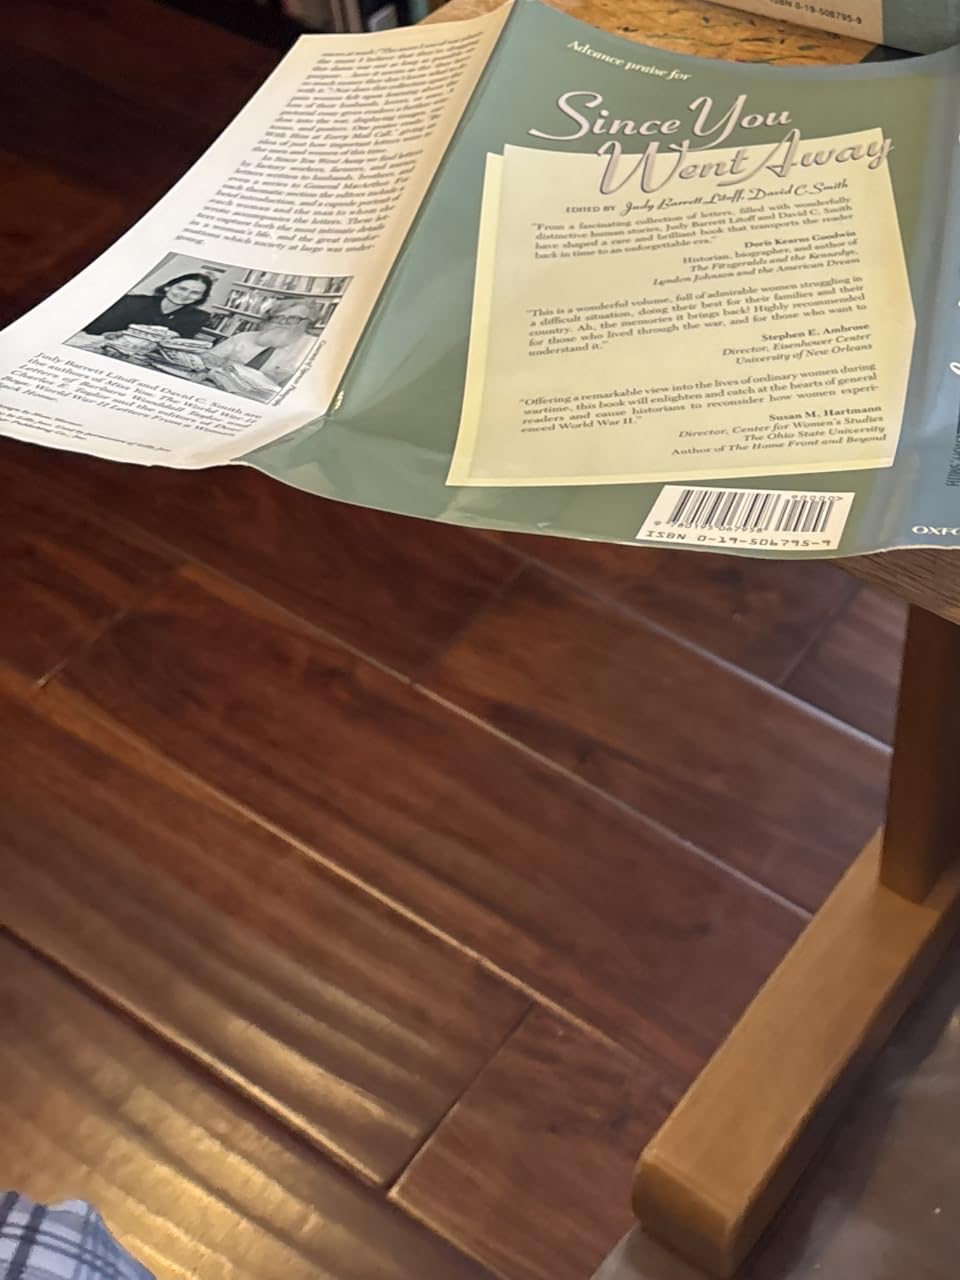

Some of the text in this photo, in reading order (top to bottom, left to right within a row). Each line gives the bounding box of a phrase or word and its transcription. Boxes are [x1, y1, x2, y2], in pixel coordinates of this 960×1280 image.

[567, 40, 692, 81] Advance praise for
[528, 91, 793, 152] Since You
[597, 128, 895, 195] Went Away
[565, 206, 600, 214] EDITED
[603, 205, 616, 213] BY
[620, 199, 655, 217] Judy
[657, 195, 703, 210] Barrett
[747, 184, 794, 201] David
[809, 178, 848, 196] Smith
[744, 230, 856, 248] Doris Kearns Goodwin
[761, 323, 870, 343] Stephen E. Ambrose
[520, 397, 571, 406] “Offering
[581, 387, 643, 401] remarkable
[645, 386, 669, 395] view
[672, 383, 694, 392] into
[695, 381, 712, 389] the
[715, 377, 740, 387] lives
[741, 375, 753, 385] of
[753, 372, 798, 385] ordinary
[800, 368, 838, 377] women
[840, 363, 877, 374] during
[523, 405, 574, 415] wartime,
[576, 402, 597, 411] this
[598, 398, 626, 408] book
[628, 396, 649, 406] will
[650, 392, 703, 405] enlighten
[705, 390, 725, 399] and
[727, 386, 755, 396] catch
[770, 383, 788, 392] the
[790, 379, 823, 389] hearts
[825, 377, 836, 386] of
[837, 373, 878, 385] general
[522, 415, 565, 424] readers
[569, 412, 591, 420] and
[595, 409, 627, 417] cause
[632, 403, 686, 415] historians
[707, 396, 765, 408] reconsider
[769, 392, 793, 402] how
[797, 389, 836, 399] women
[840, 384, 879, 396] experi-
[769, 406, 882, 422] Susan M. Hartmann
[678, 415, 884, 438] Director, Center for Women’s Studies
[744, 426, 886, 442] The Ohio State University
[671, 434, 887, 456] Author of The Home Front and Beyond
[646, 530, 832, 547] ISBN 0-19-506795-9
